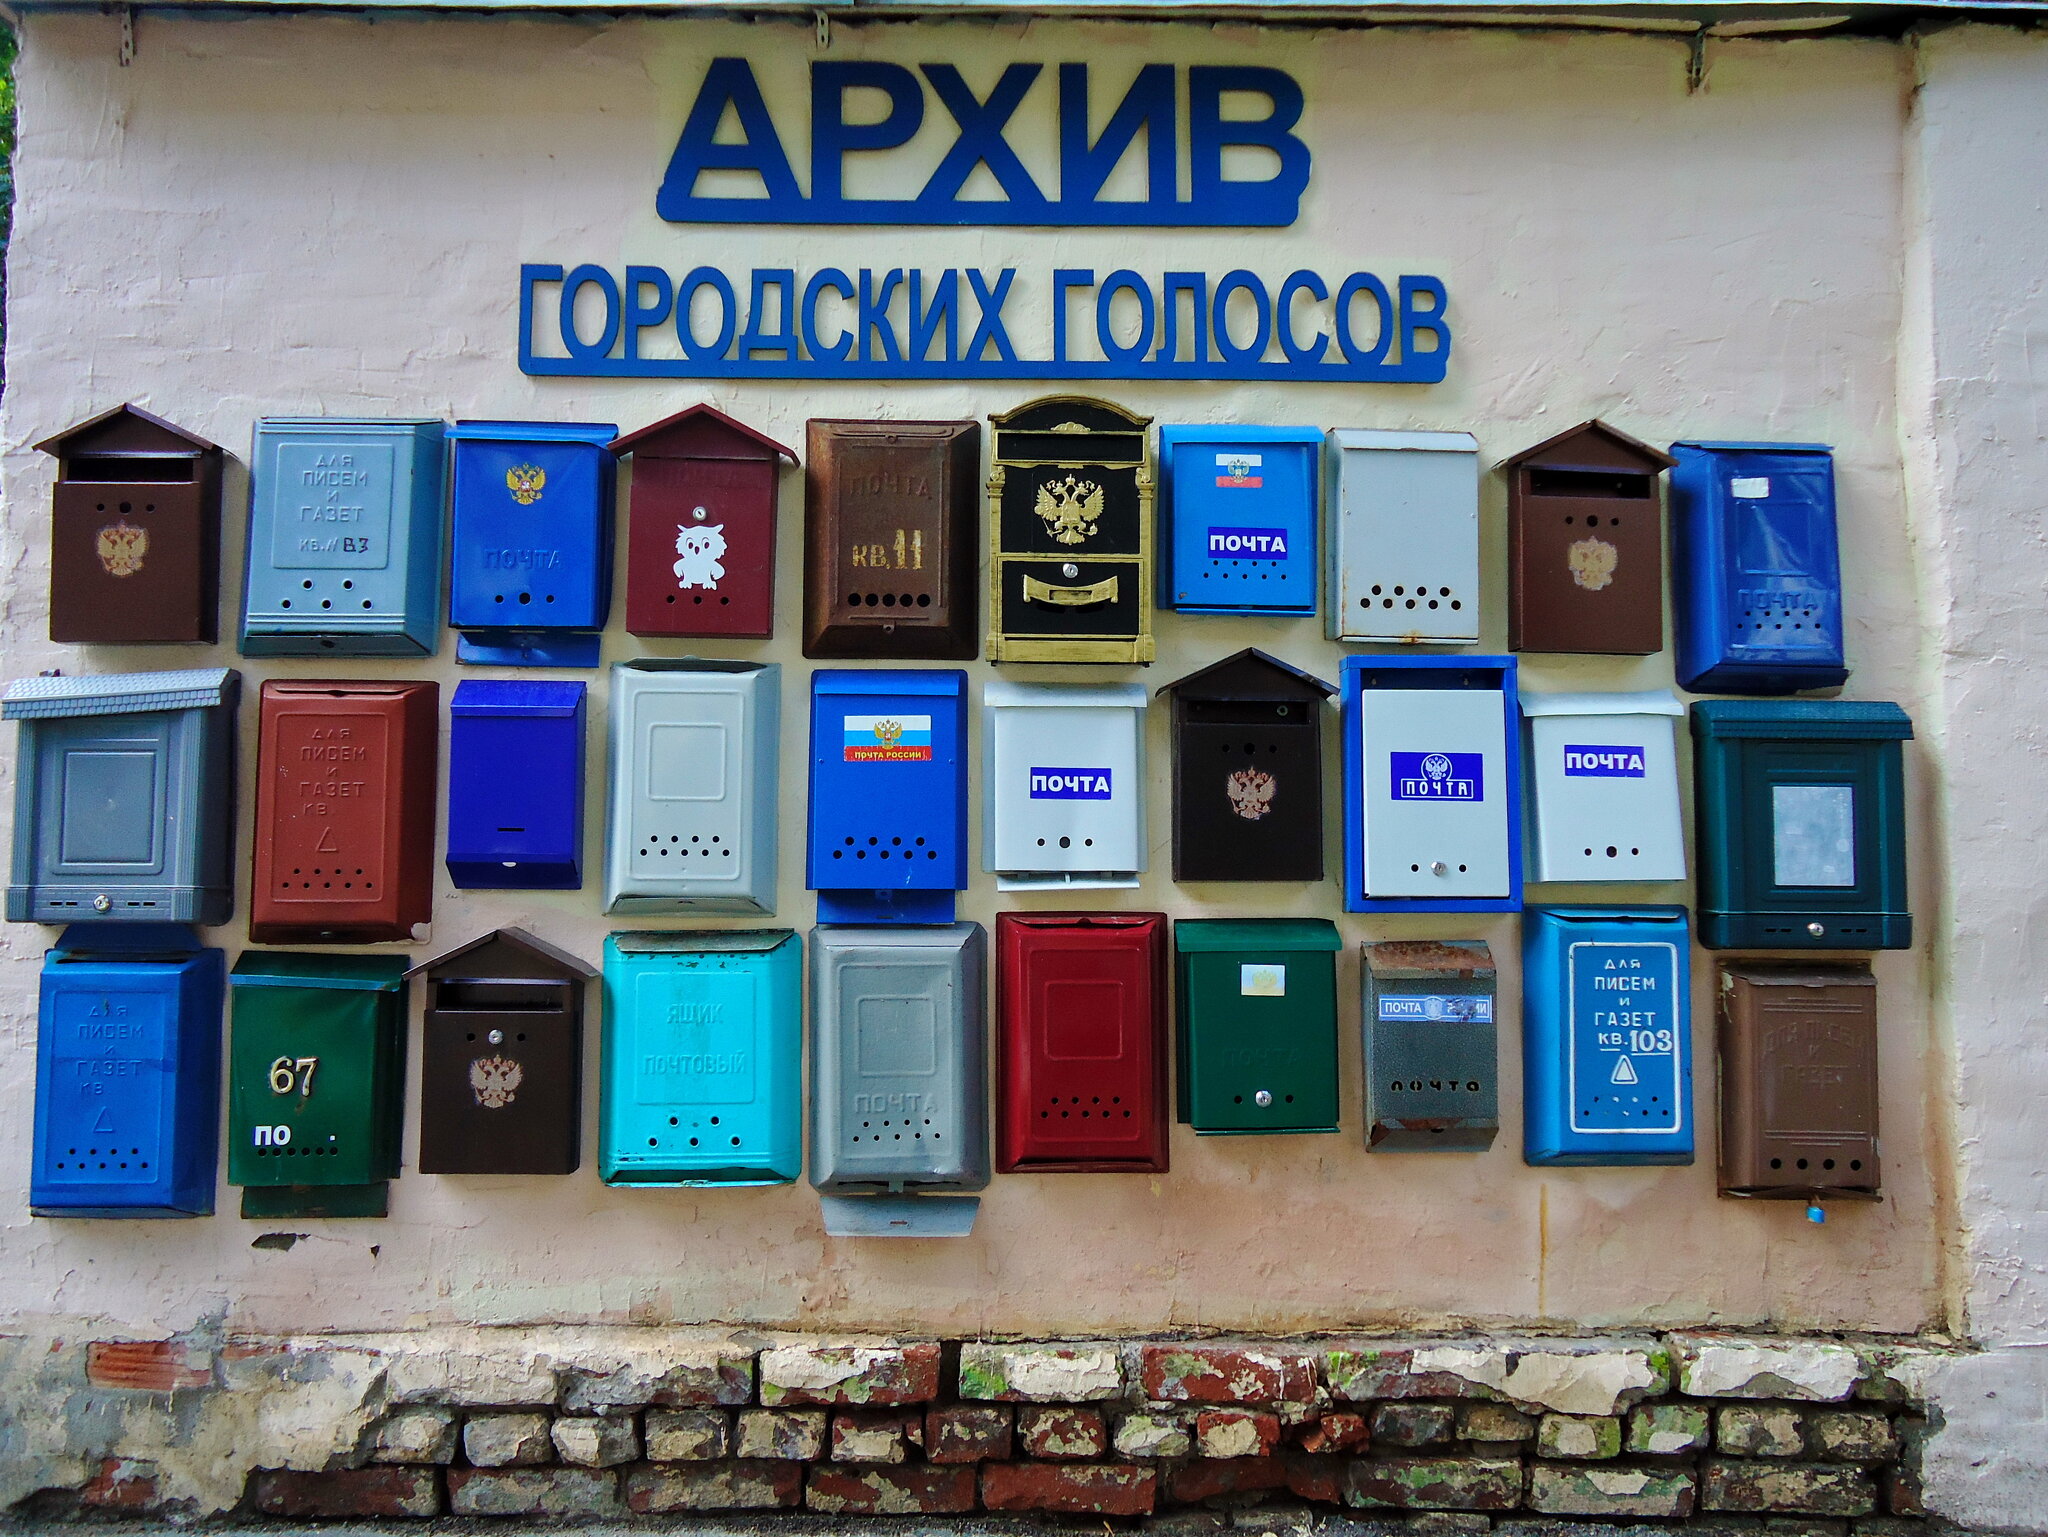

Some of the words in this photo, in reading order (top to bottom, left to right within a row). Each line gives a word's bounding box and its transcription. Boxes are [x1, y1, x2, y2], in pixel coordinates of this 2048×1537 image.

[657, 57, 1310, 214] АРХИВ
[519, 263, 1019, 368] ГОРОДСКИХ
[1054, 269, 1451, 372] ГОЛОСОВ
[316, 454, 354, 468] ДЛЯ
[302, 470, 369, 487] ПИСЕМ
[327, 489, 339, 503] И
[300, 506, 364, 522] ГАЗЕТ
[1209, 535, 1287, 553] ПОЧТА
[483, 549, 562, 569] ПОЧТА
[311, 728, 351, 739] ДЛЯ
[301, 746, 366, 761] ПИСЕМ
[854, 751, 884, 759] ПОЧТА
[886, 751, 922, 759] РОССИИ
[1566, 753, 1644, 770] ПОЧТА
[300, 781, 366, 797] ГАЗЕТ
[1032, 775, 1110, 793] ПОЧТА
[1406, 781, 1468, 796] ПОЧТА
[1604, 958, 1641, 970] ДЛЯ
[1594, 976, 1656, 991] ПИСЕМ
[1385, 1002, 1422, 1013] ПОЧТА
[1619, 997, 1631, 1007] И
[667, 1003, 723, 1024] ЯЩИК
[1594, 1011, 1656, 1027] ГАЗЕТ
[77, 1024, 144, 1040] ПИСЕМ
[76, 1060, 143, 1076] ГАЗЕТ
[644, 1049, 745, 1075] ПОЧТОВЫЙ
[270, 1056, 319, 1097] 67
[855, 1092, 938, 1114] ПОЧТА
